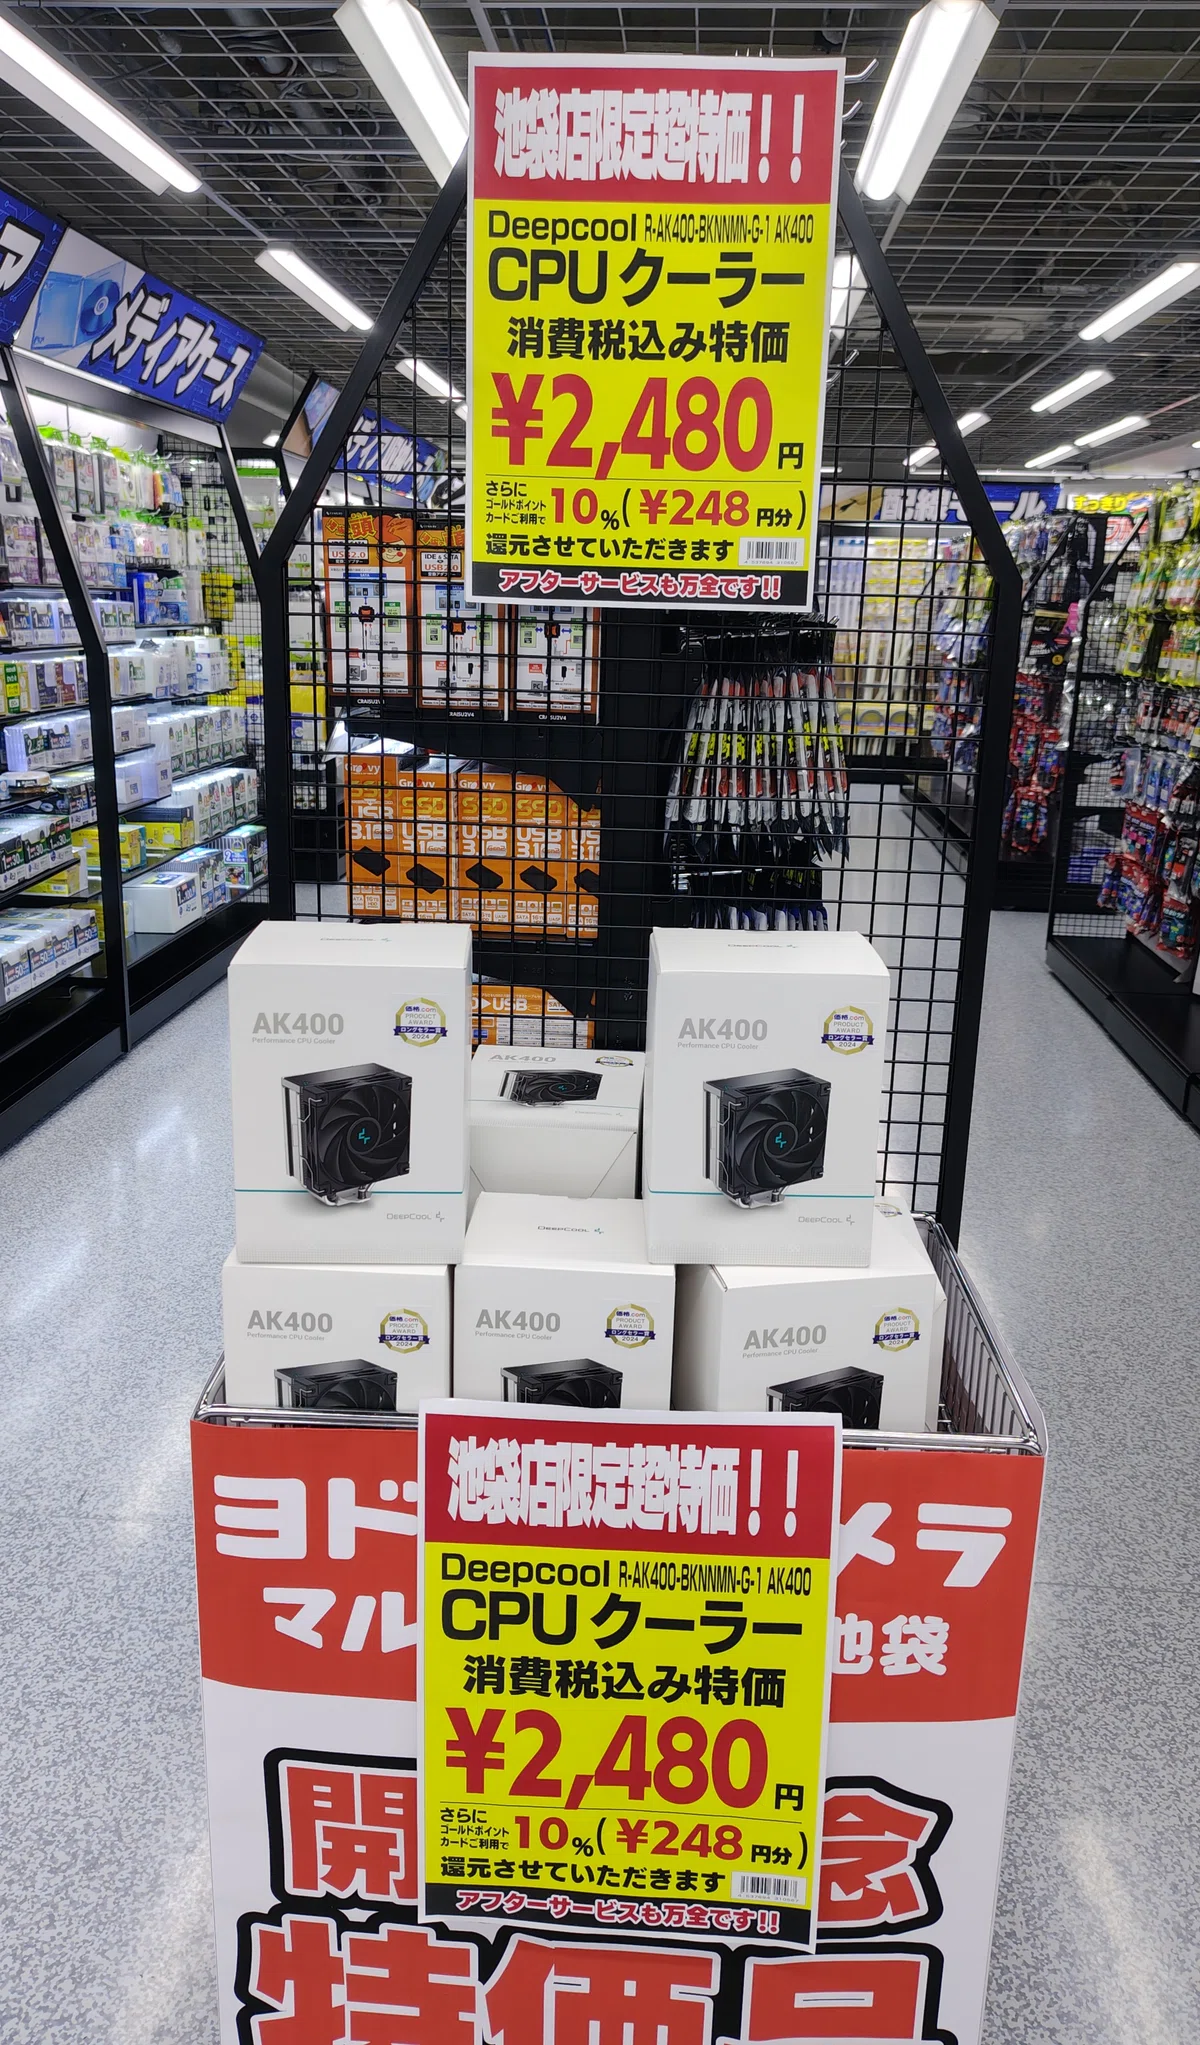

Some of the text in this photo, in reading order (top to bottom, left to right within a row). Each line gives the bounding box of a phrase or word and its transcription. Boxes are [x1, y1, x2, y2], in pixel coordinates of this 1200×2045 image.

[488, 210, 814, 245] Deepcool R-AK400-BKNNMN-G-1 AK400
[91, 290, 250, 408] メディアケース
[507, 316, 791, 363] 消費税込み特価
[486, 481, 527, 497] さらに
[486, 499, 547, 511] ゴールドポイント
[486, 512, 546, 526] カードご利用で
[486, 533, 734, 561] 還元させていただきます
[252, 1012, 344, 1035] AK400
[678, 1018, 768, 1041] AK400
[252, 1036, 296, 1044] Performance
[247, 1310, 333, 1333] AK400
[475, 1309, 560, 1332] AK400
[247, 1331, 288, 1339] Performance
[475, 1330, 515, 1338] Performance
[743, 1325, 827, 1350] AK400
[742, 1351, 782, 1359] Performance
[441, 1552, 811, 1596] Deepcool R-AK400-BKNNMN-G-1 AK400
[463, 1654, 786, 1708] 消費税込み特価
[440, 1808, 488, 1824] さらに
[440, 1823, 510, 1838] ゴールドポイント
[440, 1837, 509, 1850] カードご利用で
[440, 1855, 726, 1893] 還元させていただきます
